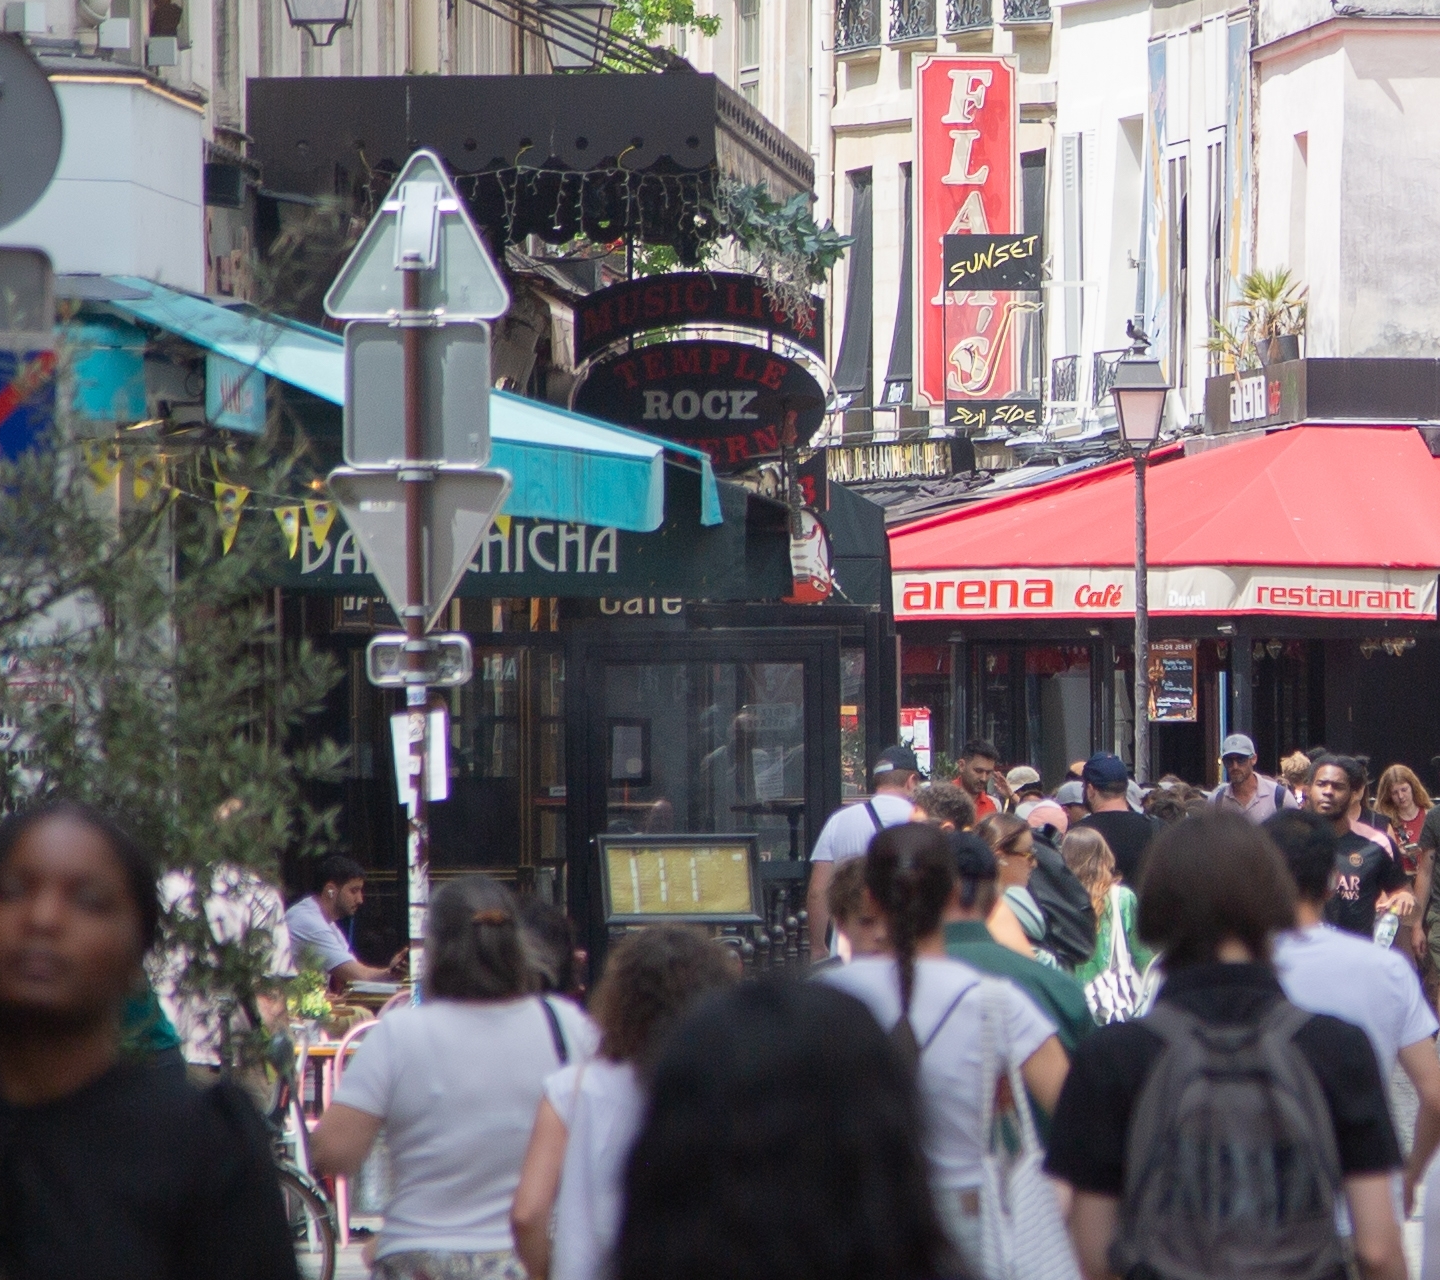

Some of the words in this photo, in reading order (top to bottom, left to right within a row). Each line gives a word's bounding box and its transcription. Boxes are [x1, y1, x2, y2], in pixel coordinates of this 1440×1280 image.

[948, 235, 1039, 287] SUNSET
[582, 280, 710, 341] MUSIC
[613, 347, 788, 391] TEMPLE
[642, 389, 759, 420] ROCK
[995, 402, 1036, 423] SIDE
[464, 525, 618, 574] HICHA
[902, 578, 1054, 611] arena
[1074, 584, 1124, 608] Café
[1257, 584, 1417, 610] restaurant
